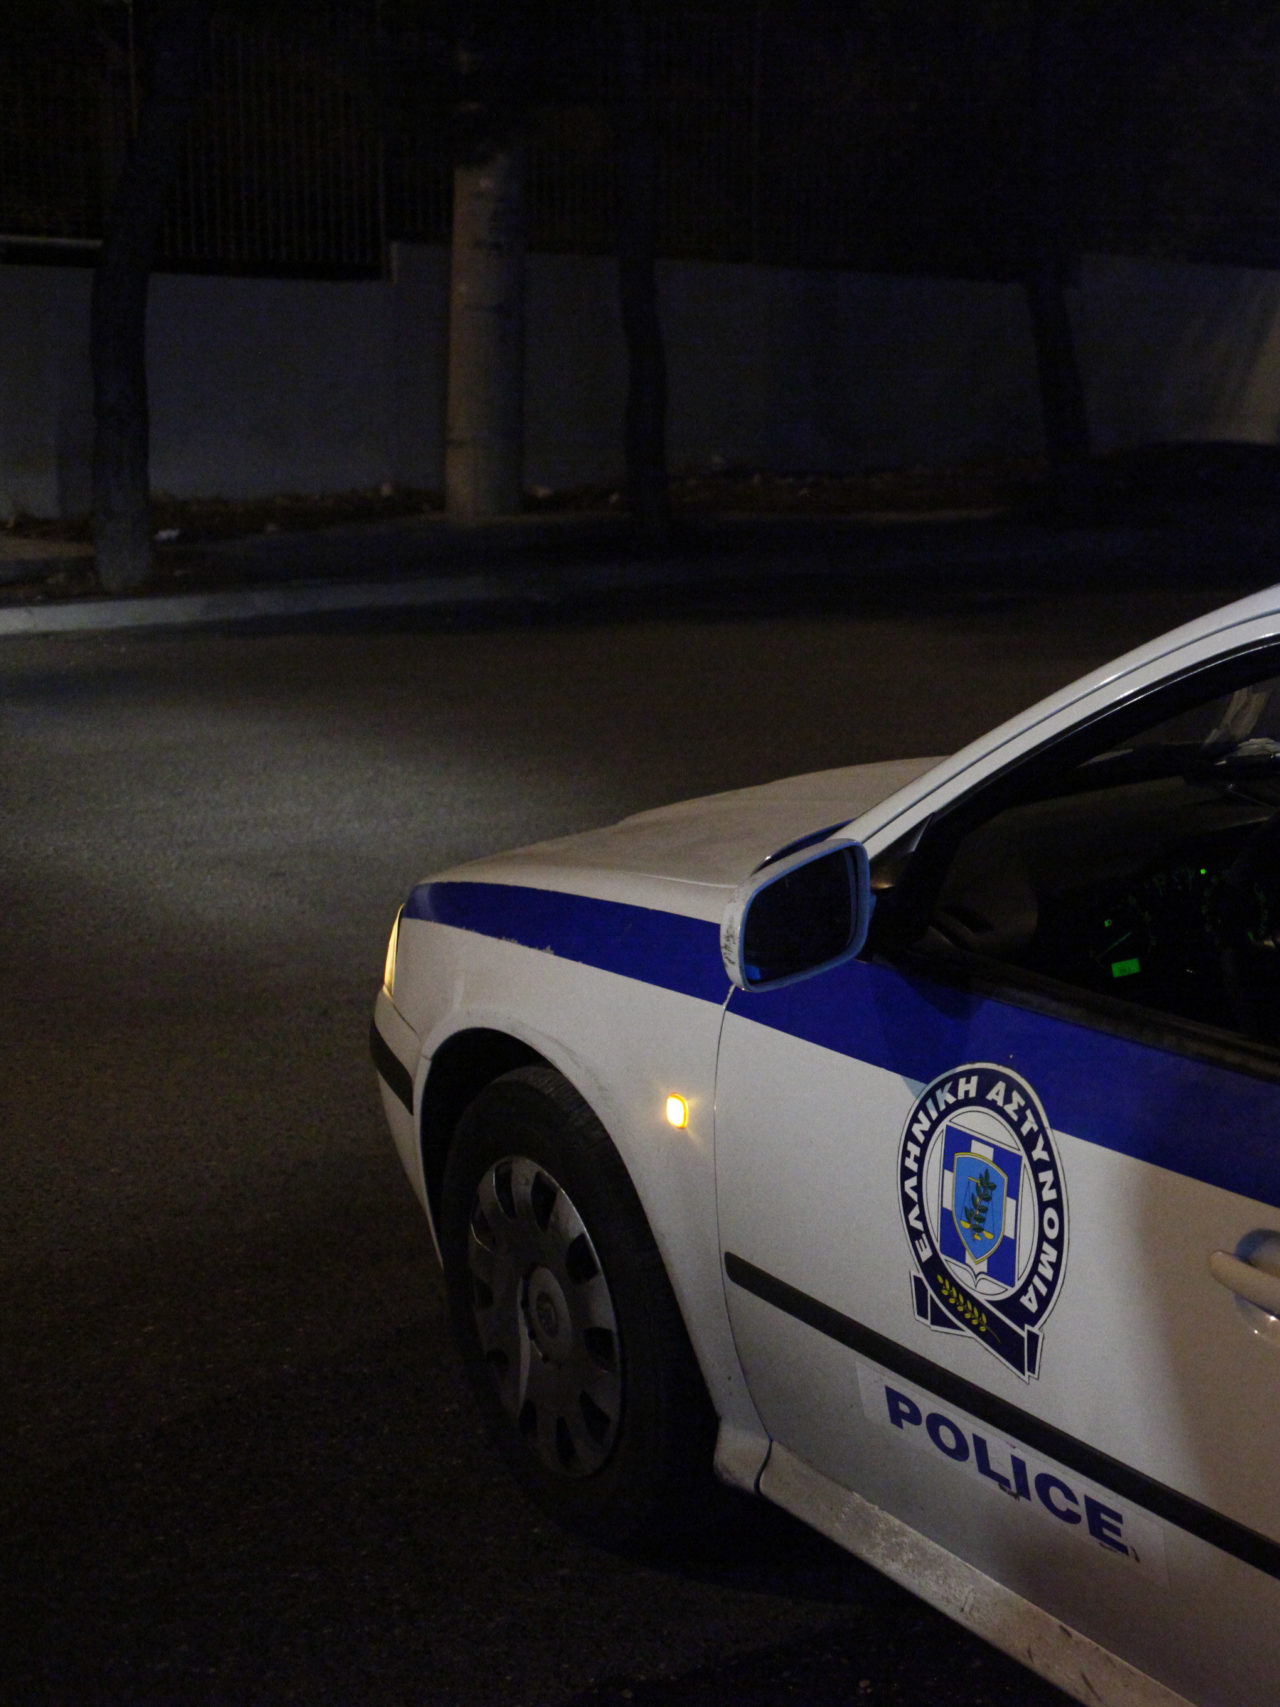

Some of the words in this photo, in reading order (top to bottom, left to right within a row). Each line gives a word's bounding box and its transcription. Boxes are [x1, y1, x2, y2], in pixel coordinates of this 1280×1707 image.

[904, 1075, 979, 1263] ΕΛΛΗΝΙΚΗ
[986, 1080, 1060, 1314] ΑΣΤΥΝΟΜΙΑ
[885, 1385, 1129, 1556] POLICE
